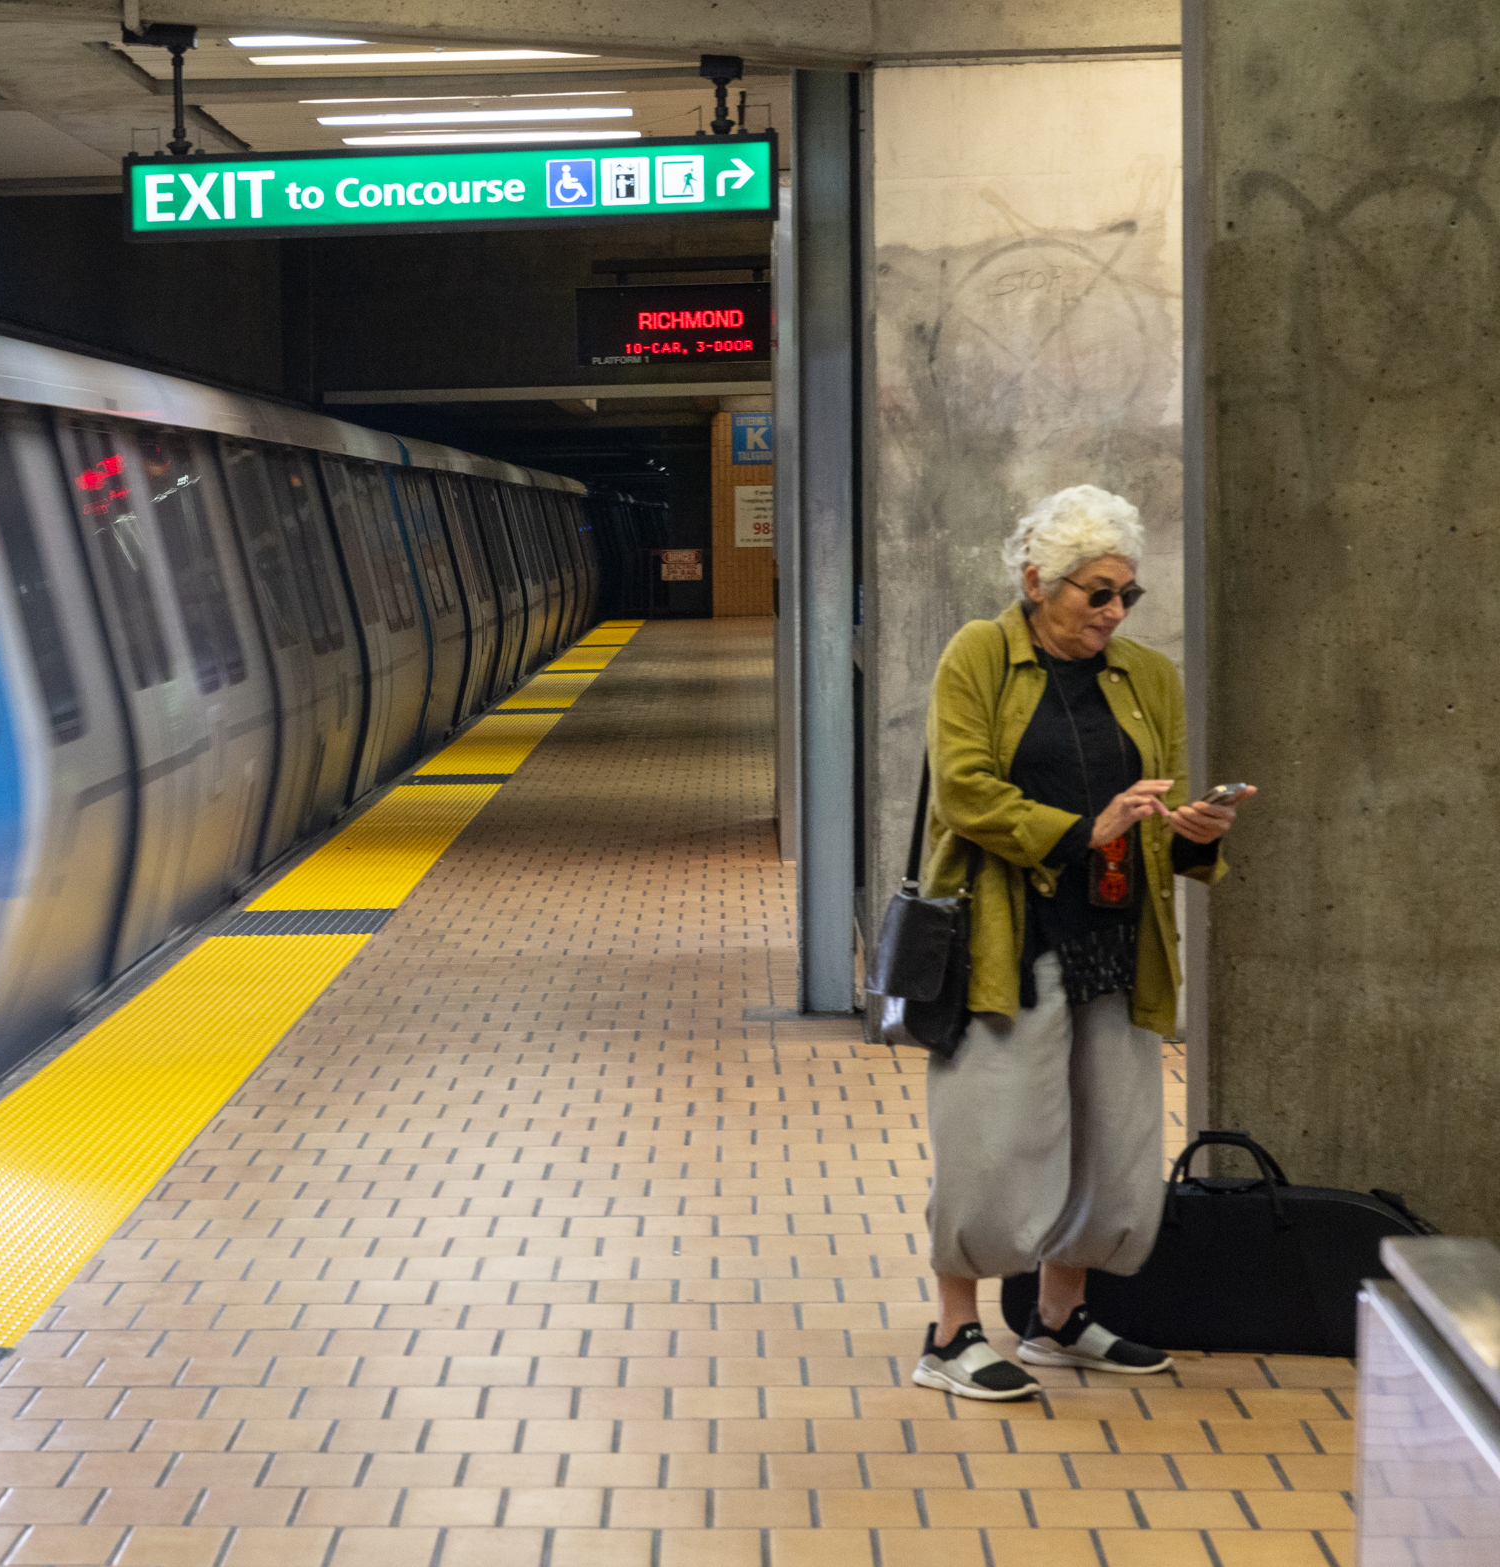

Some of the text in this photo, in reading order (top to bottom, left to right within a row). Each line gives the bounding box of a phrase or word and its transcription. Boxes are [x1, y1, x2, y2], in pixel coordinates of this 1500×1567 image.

[144, 170, 526, 223] EXIT to Concourse
[638, 309, 744, 331] RICHMOND
[625, 340, 753, 355] 10-CAR, 3-DOOR
[592, 356, 650, 365] PLATFORM 1
[746, 427, 769, 450] K
[753, 522, 773, 535] 98
